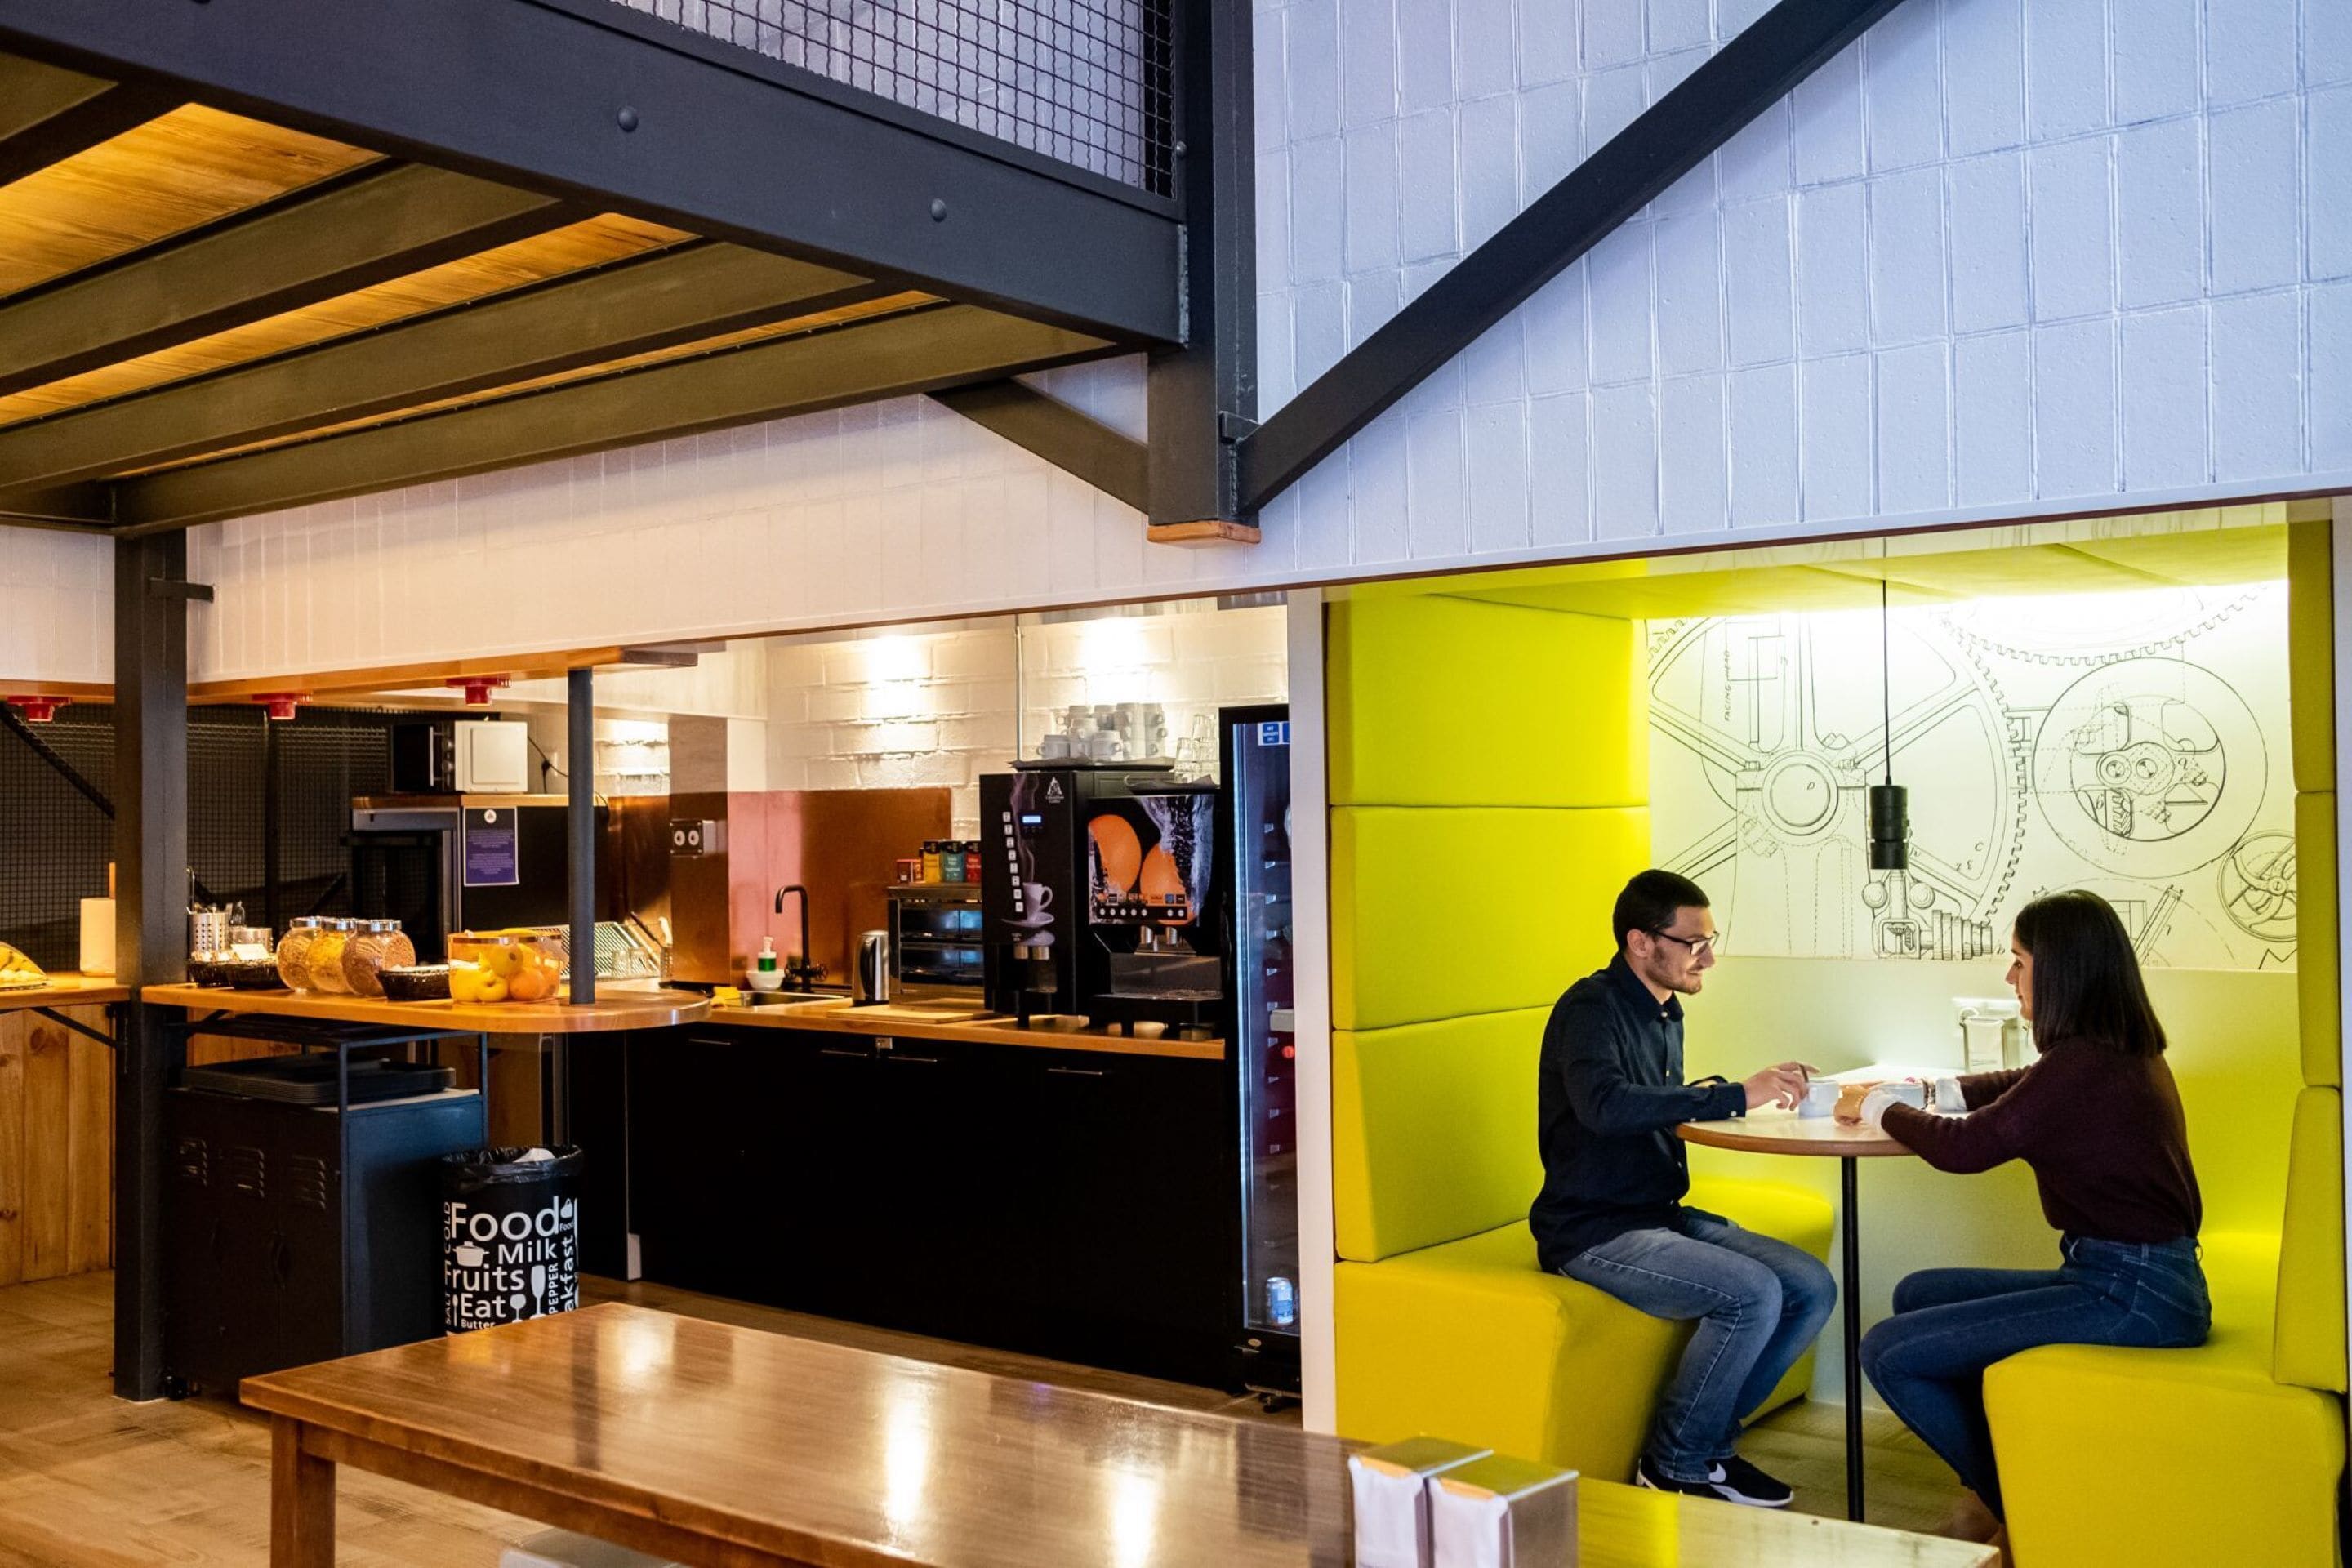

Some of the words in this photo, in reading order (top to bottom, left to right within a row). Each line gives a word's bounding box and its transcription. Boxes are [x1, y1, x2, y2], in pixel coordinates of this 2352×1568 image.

[452, 1195, 559, 1241] Food
[498, 1238, 557, 1265] Milk
[444, 1260, 525, 1292] Fruits
[548, 1263, 559, 1315] PEPPER
[461, 1293, 506, 1318] Eat
[461, 1319, 496, 1330] Butter
